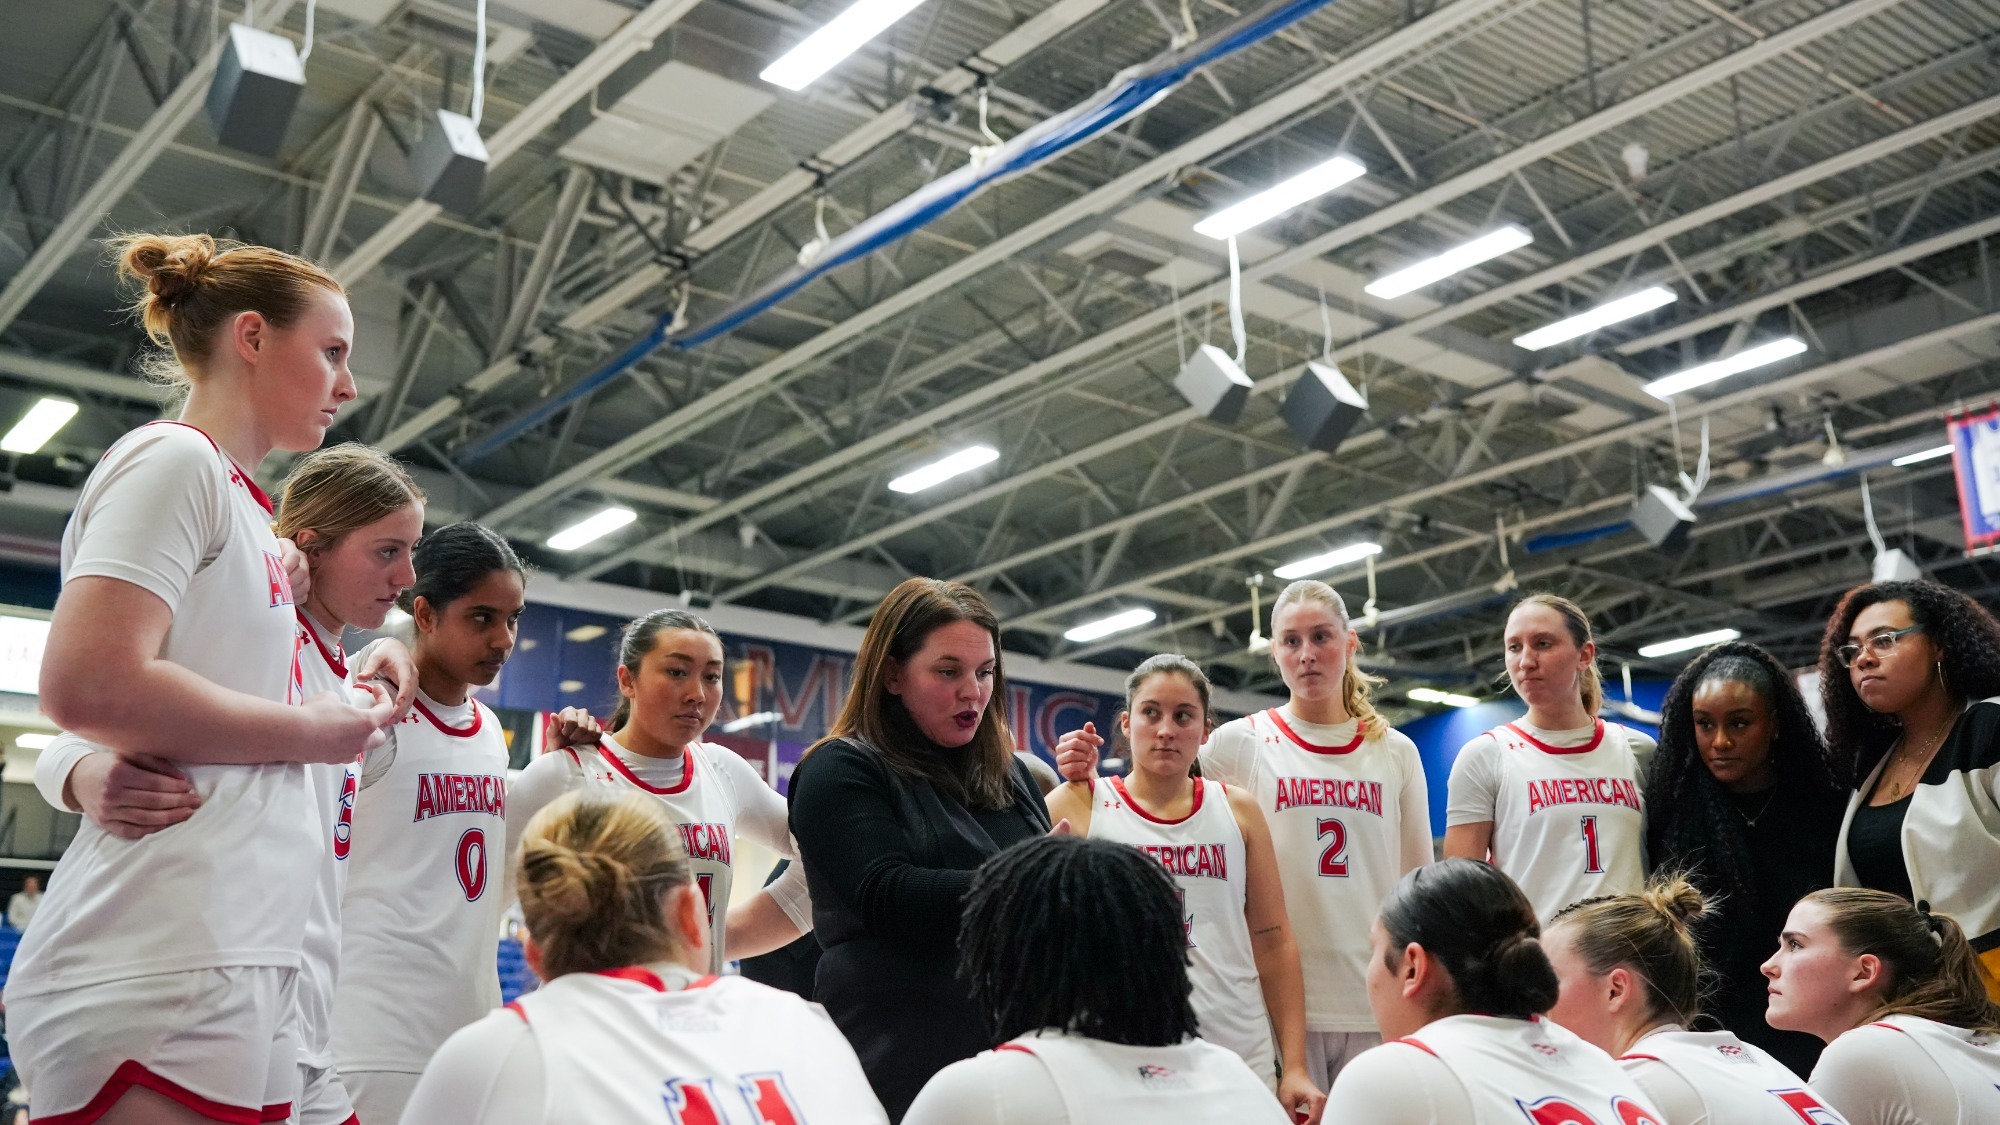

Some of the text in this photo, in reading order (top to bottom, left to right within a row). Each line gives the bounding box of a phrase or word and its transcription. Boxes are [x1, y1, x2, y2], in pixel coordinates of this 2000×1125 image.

[413, 773, 505, 822] AMERICA
[1275, 776, 1383, 818] AMERICAN
[1527, 777, 1642, 816] AMERICAN
[455, 827, 488, 902] 0
[1316, 817, 1349, 878] 2
[1581, 815, 1604, 874] 1
